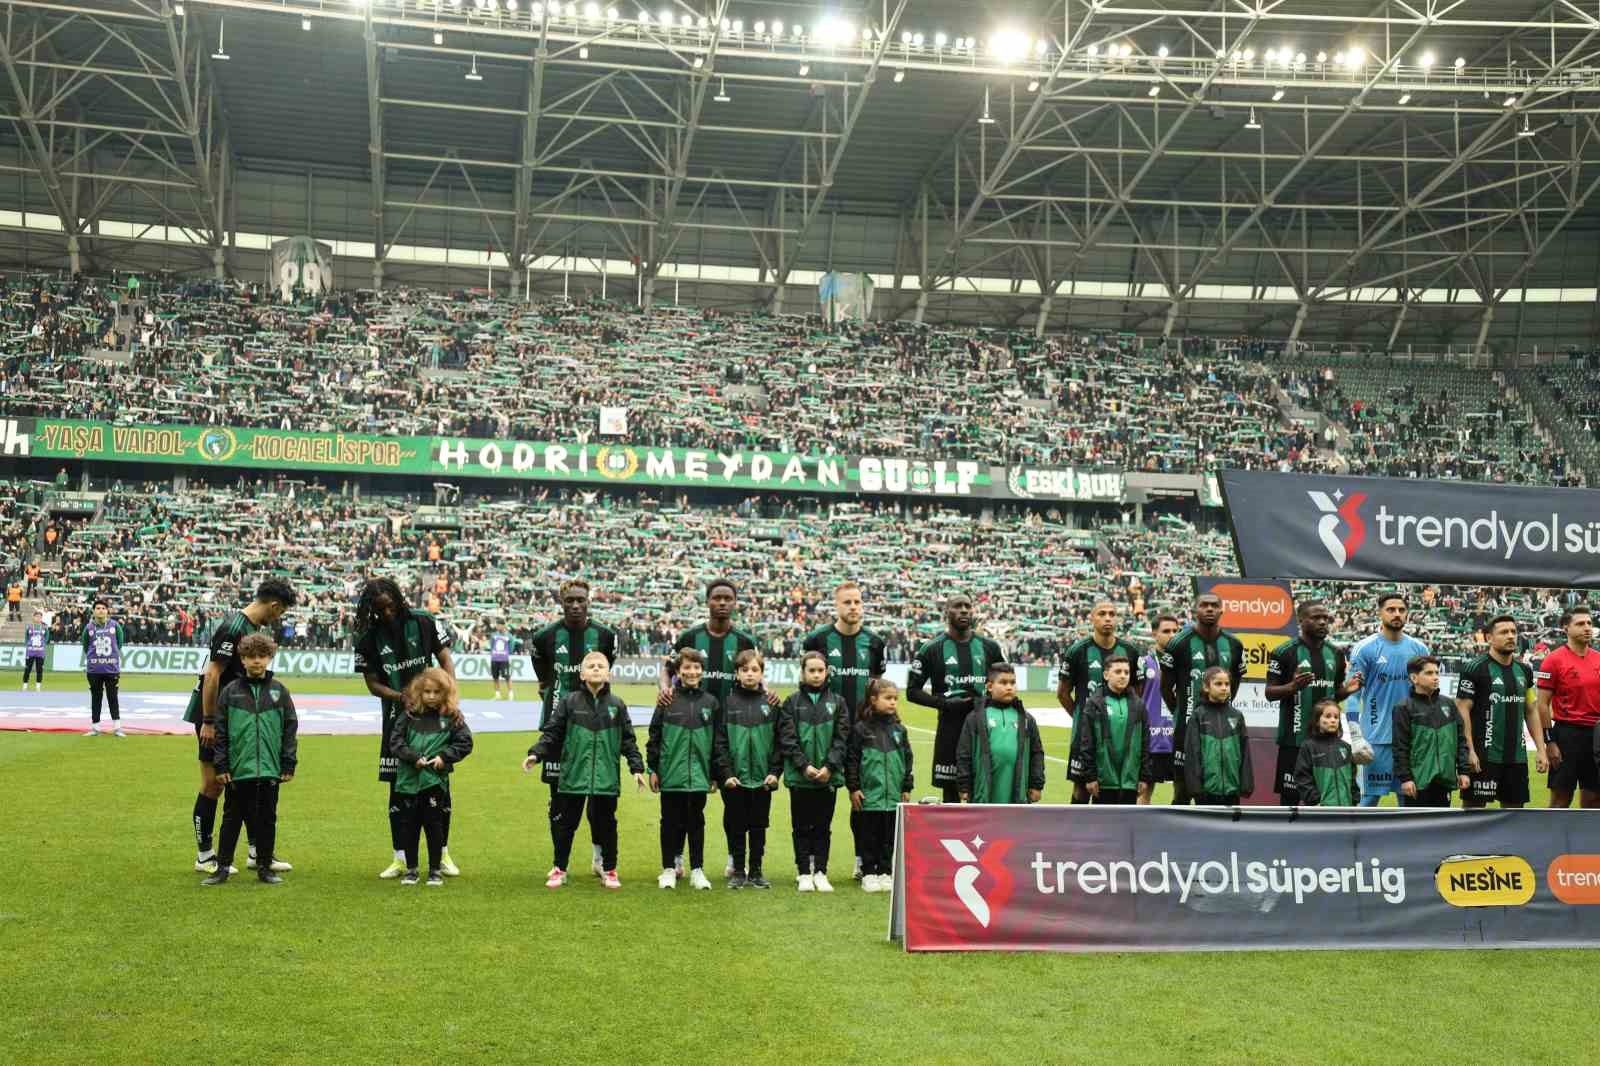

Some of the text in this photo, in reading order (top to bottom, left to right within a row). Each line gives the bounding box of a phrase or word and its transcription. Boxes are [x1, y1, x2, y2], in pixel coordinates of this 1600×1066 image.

[44, 424, 183, 456] YAŞA VAROL
[253, 433, 400, 466] KOCAELİSPOR
[646, 450, 840, 486] MEYDAN
[1376, 505, 1558, 560] trendyol
[1222, 598, 1285, 617] rendyol
[120, 649, 199, 669] YONER
[1031, 851, 1240, 904] trendyol
